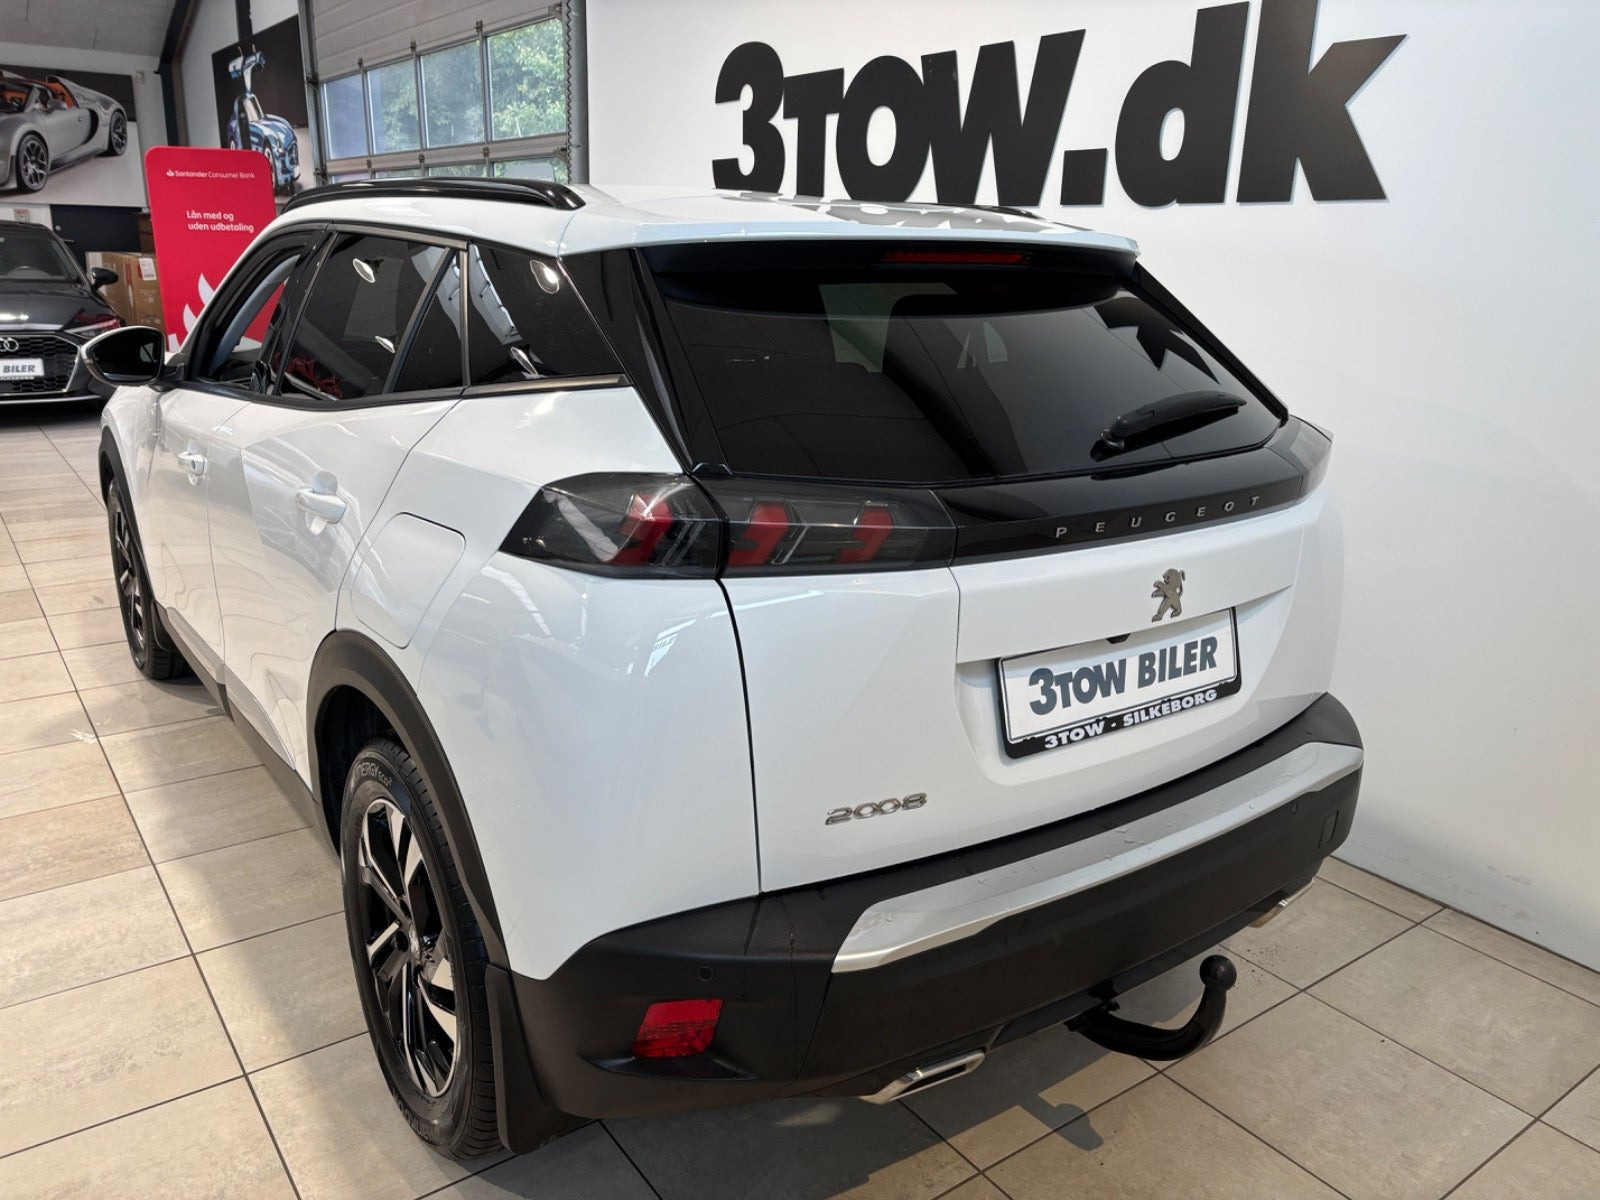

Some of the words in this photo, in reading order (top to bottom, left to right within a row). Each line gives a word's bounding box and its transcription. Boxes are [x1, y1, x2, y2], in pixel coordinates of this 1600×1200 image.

[175, 170, 208, 178] Santander
[186, 210, 202, 219] Lån
[203, 211, 222, 220] med
[223, 213, 234, 222] og
[188, 222, 209, 231] uden
[210, 222, 254, 233] udbetaling
[3, 364, 35, 373] BILER
[1055, 495, 1259, 539] PEUGEOT
[1029, 657, 1127, 716] 3TOW
[1137, 636, 1218, 689] BILER
[1044, 718, 1105, 749] 3TOW
[1123, 689, 1218, 726] SILKEBORG
[825, 792, 928, 825] 2008
